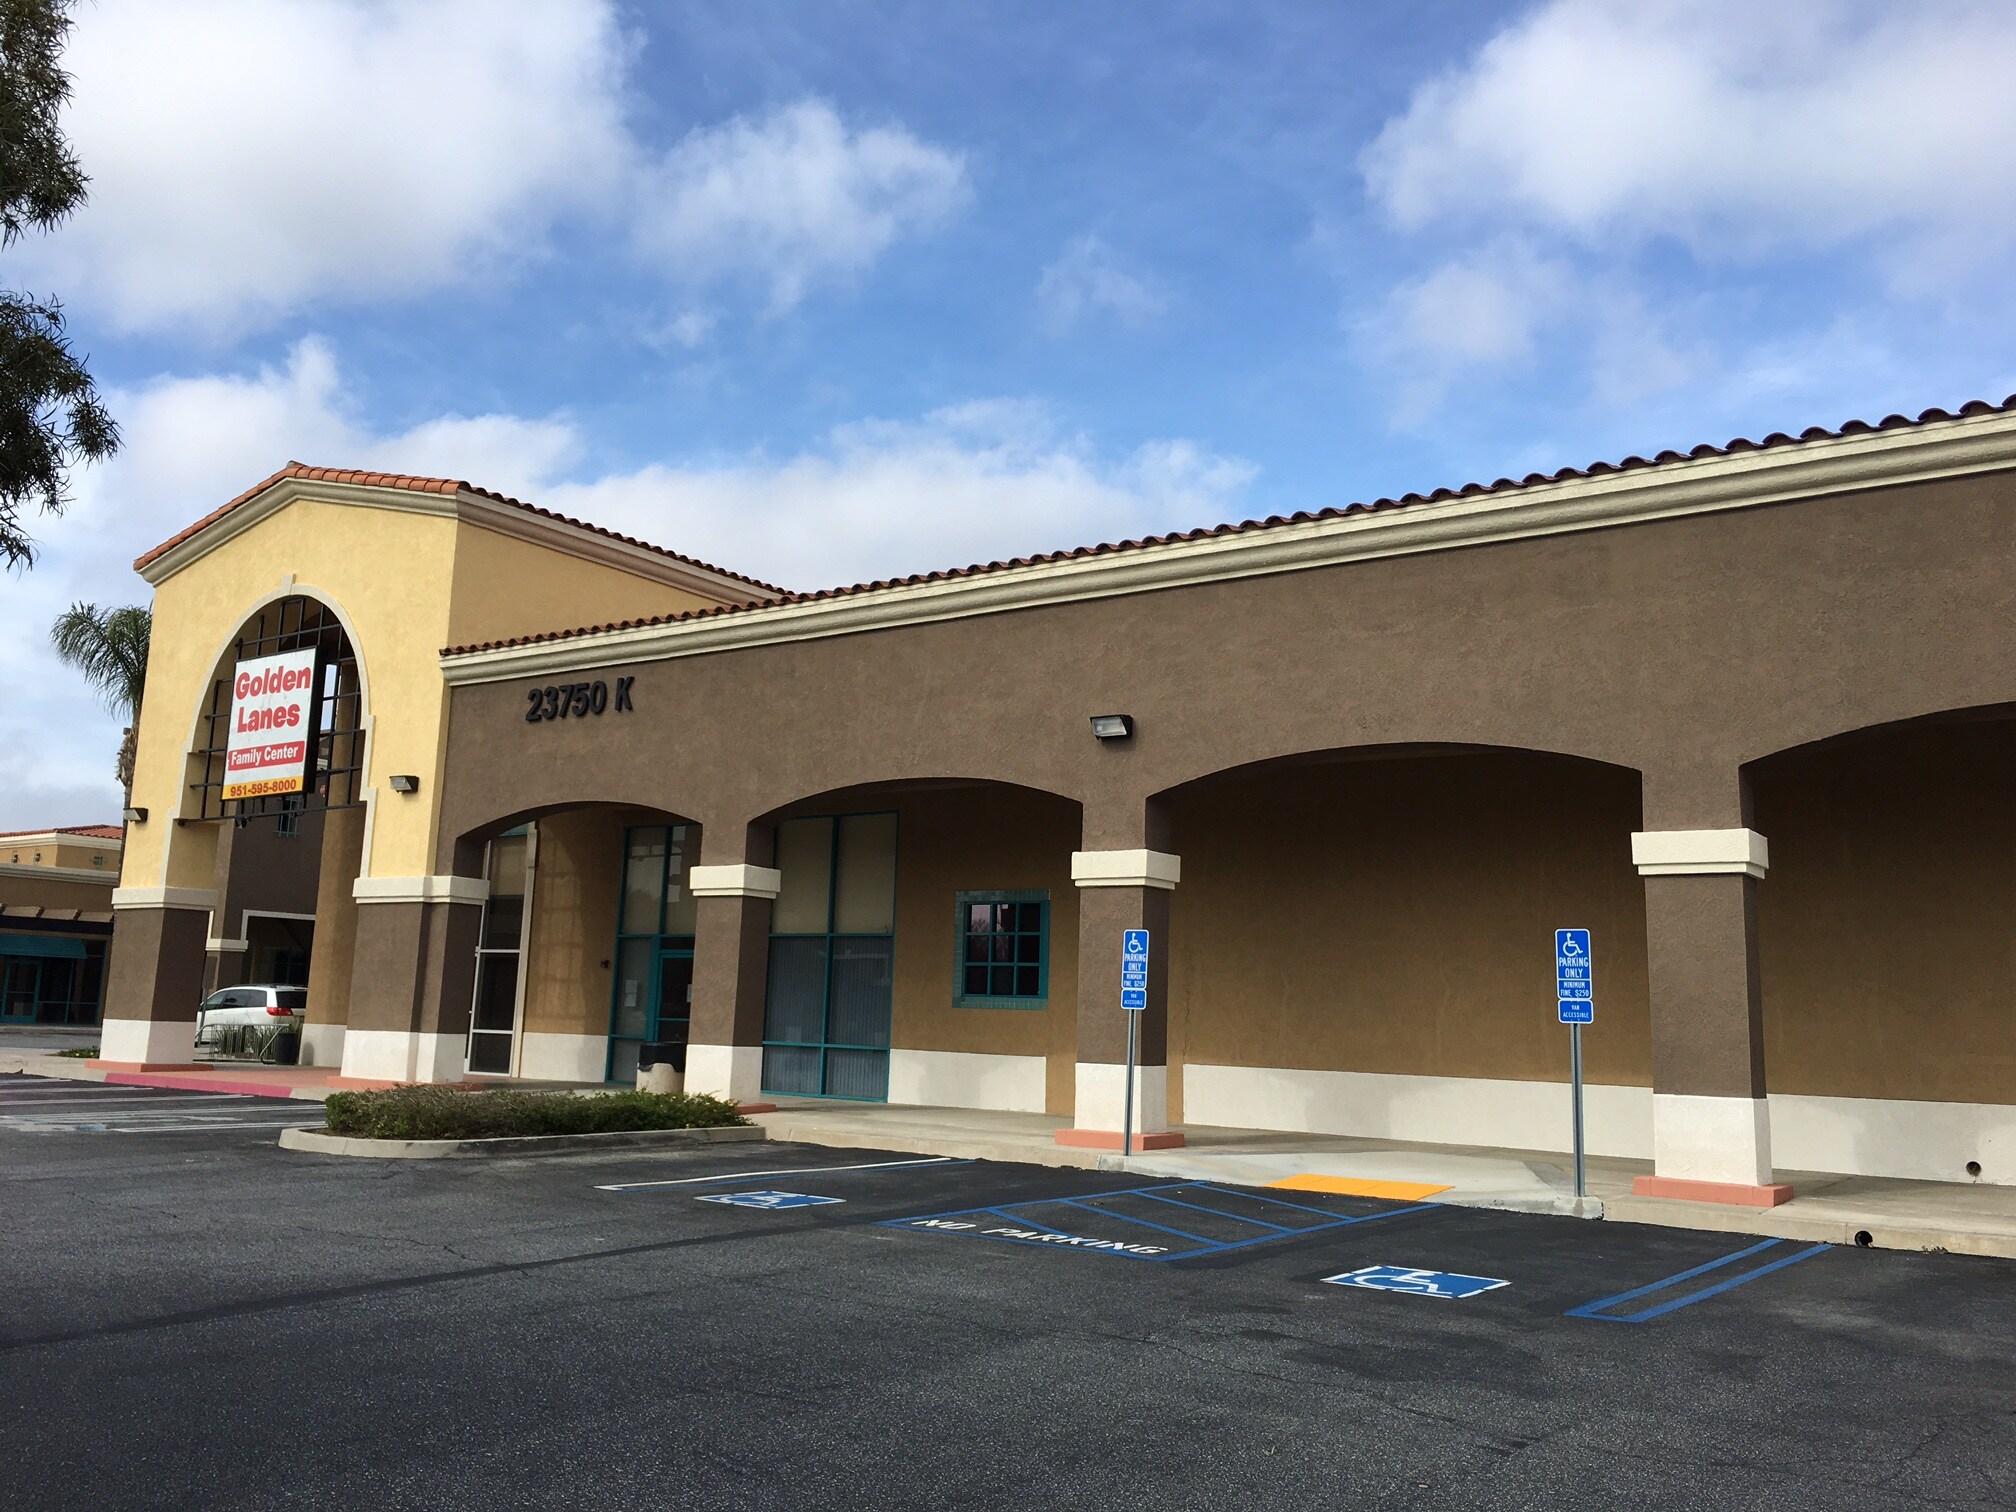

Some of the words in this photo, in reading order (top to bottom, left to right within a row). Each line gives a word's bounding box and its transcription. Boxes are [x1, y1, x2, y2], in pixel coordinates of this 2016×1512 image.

[235, 665, 311, 700] Golden
[525, 680, 608, 721] 23750
[615, 676, 635, 711] K
[237, 703, 301, 733] Lanes
[231, 748, 262, 766] Family
[264, 745, 299, 761] Center
[230, 779, 297, 797] 951-595-8000
[1124, 953, 1146, 962] PARKING
[1128, 963, 1142, 971] ONLY
[1559, 957, 1589, 967] PARKING
[1565, 968, 1583, 978] ONLY
[911, 1219, 976, 1230] NO
[981, 1227, 1168, 1254] PARKING
